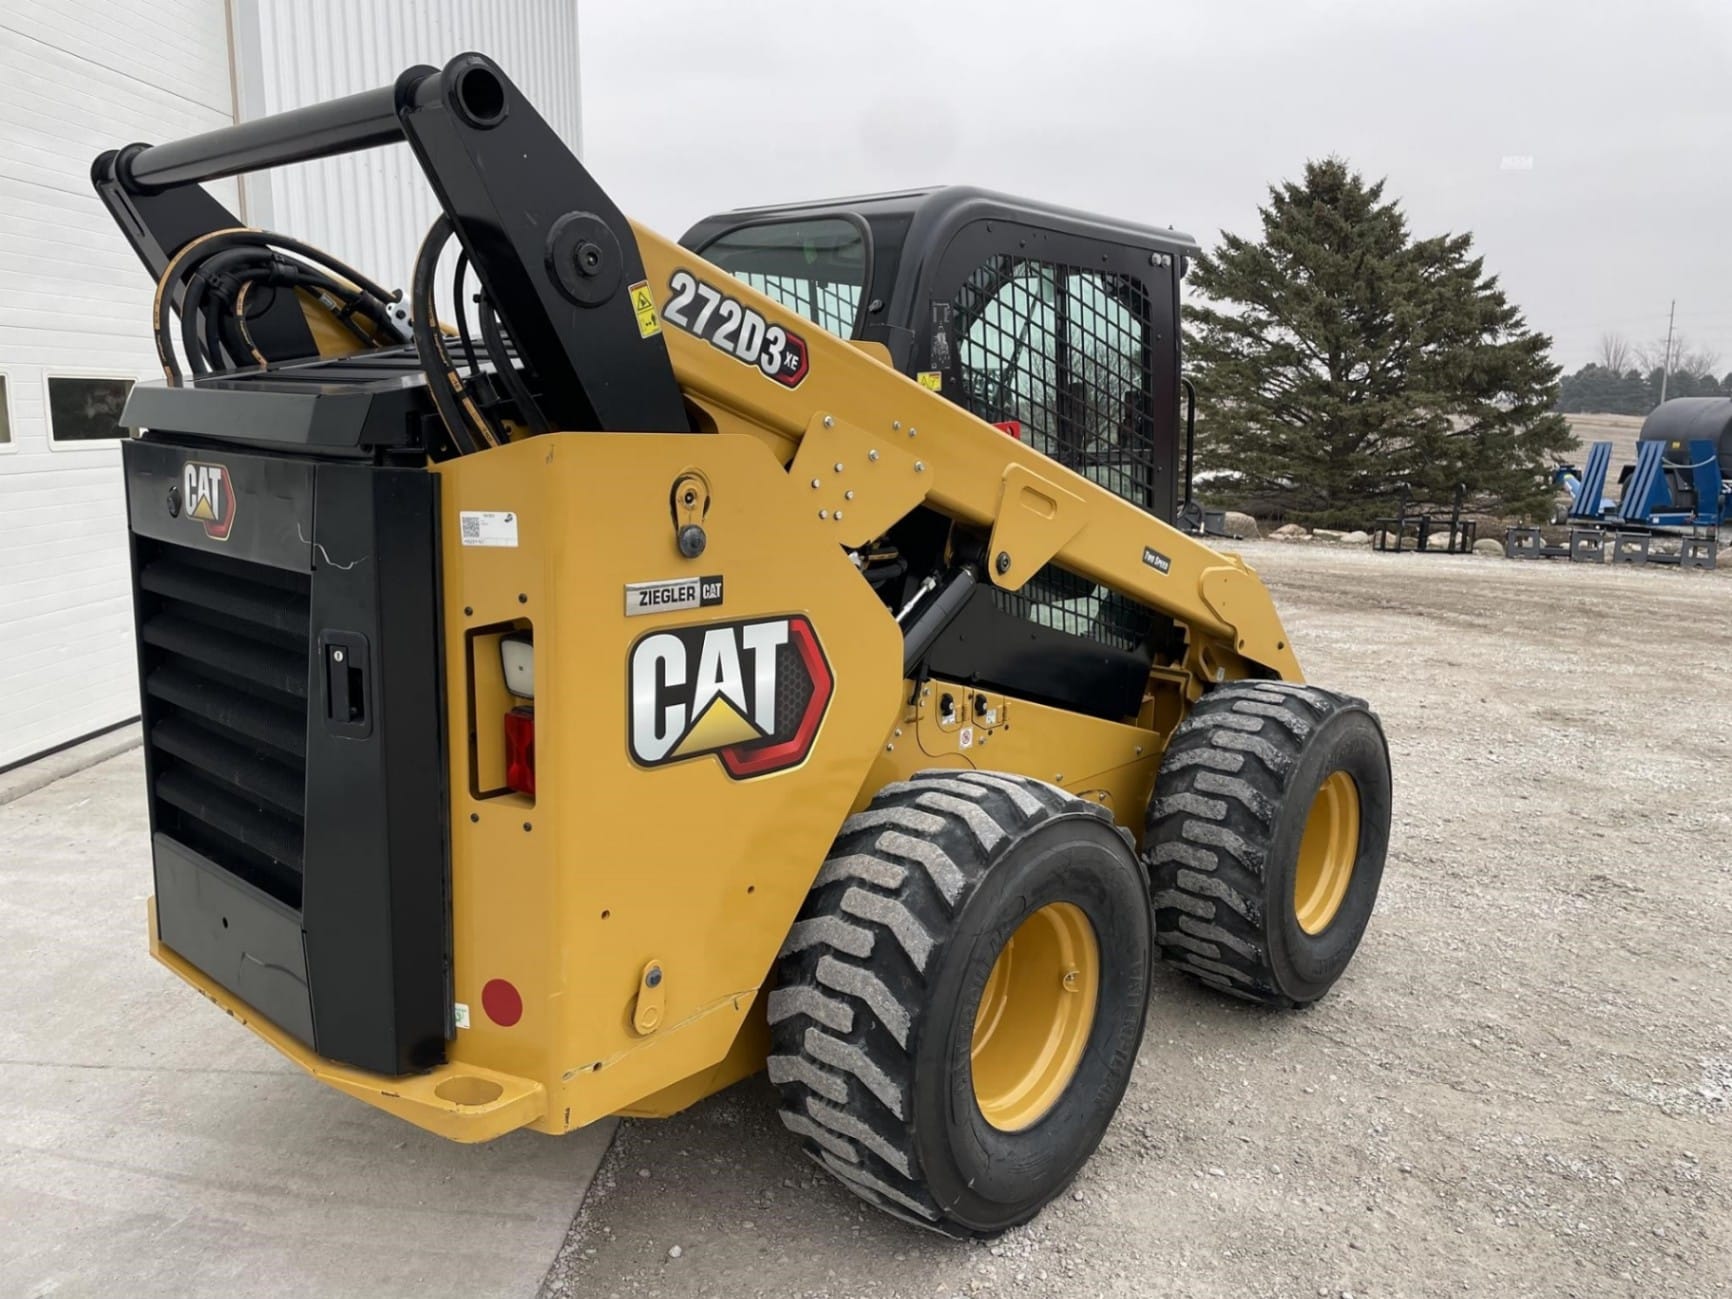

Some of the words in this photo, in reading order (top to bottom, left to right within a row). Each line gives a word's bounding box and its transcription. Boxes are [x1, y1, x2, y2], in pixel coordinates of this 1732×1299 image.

[663, 272, 787, 375] 272D3
[783, 351, 799, 371] XE
[184, 463, 222, 521] CAT
[639, 586, 696, 607] ZIEGLER
[702, 583, 722, 600] CAT
[632, 619, 789, 762] CAT
